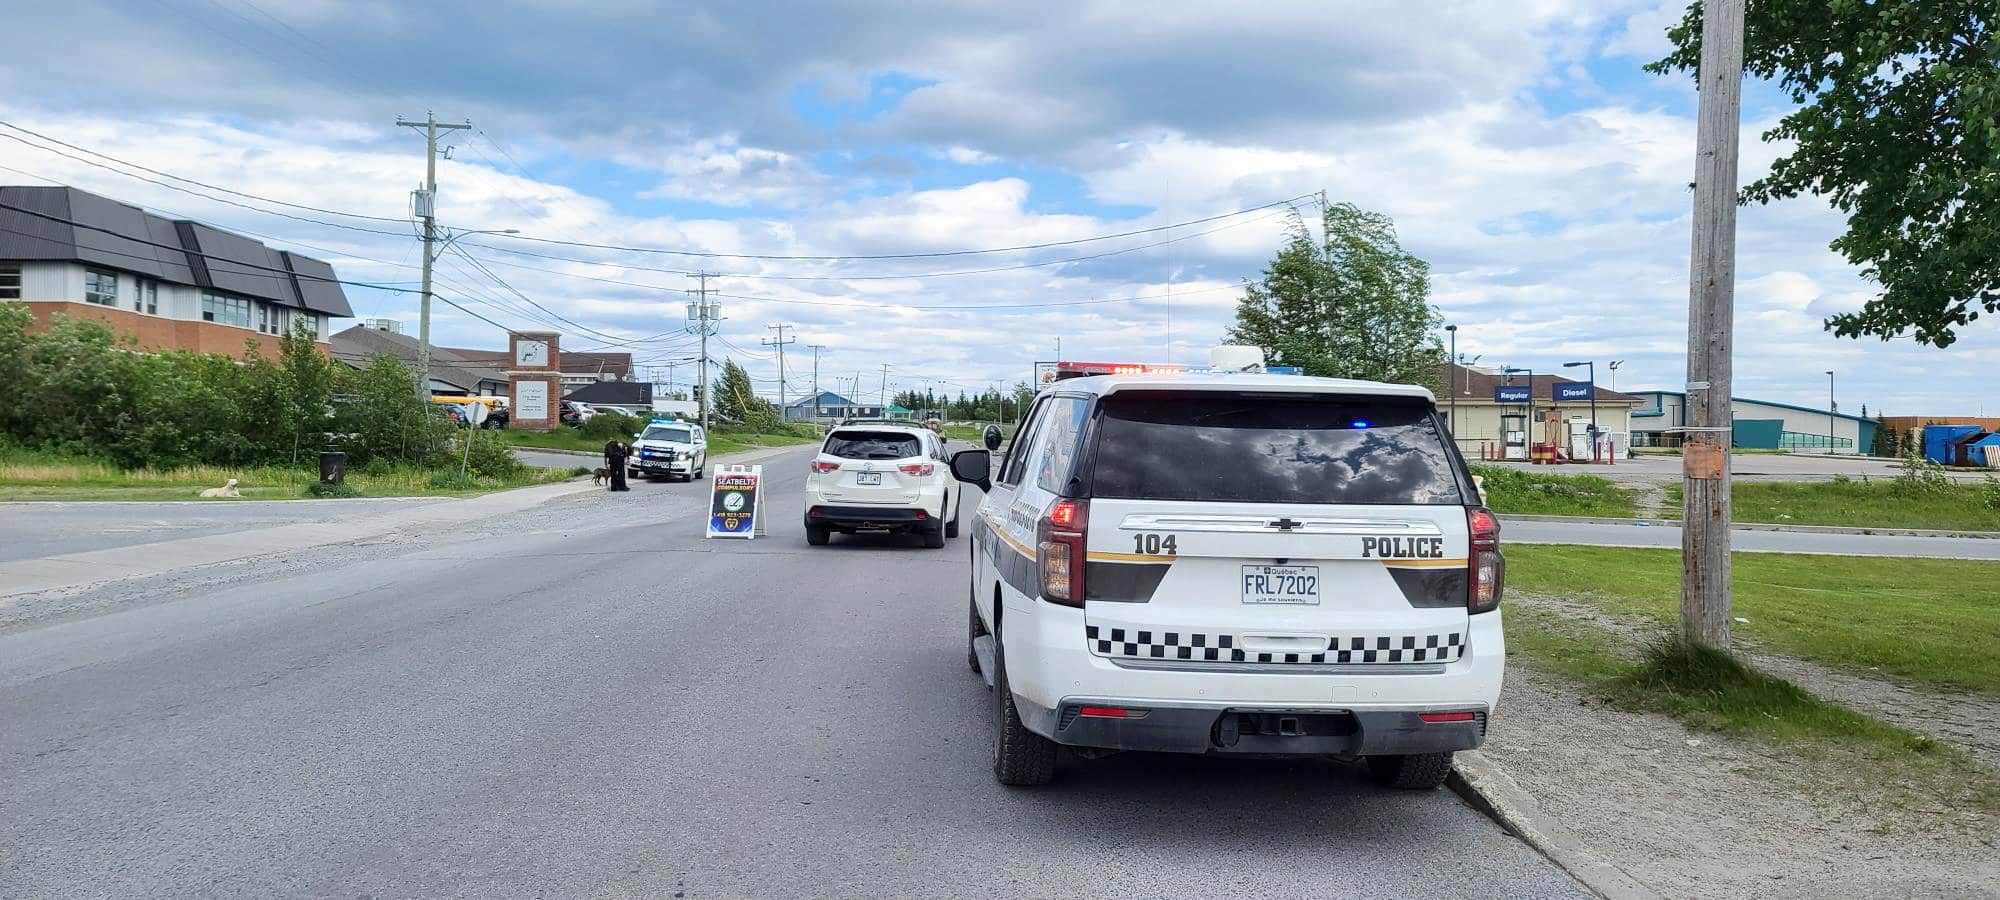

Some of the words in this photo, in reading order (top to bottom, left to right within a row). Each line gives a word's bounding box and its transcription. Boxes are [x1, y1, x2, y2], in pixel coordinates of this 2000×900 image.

[1500, 392, 1528, 400] Regular
[1562, 389, 1587, 397] Diesel
[1134, 534, 1177, 555] 104
[1361, 536, 1443, 558] POLICE
[1245, 575, 1317, 595] FRL7202
